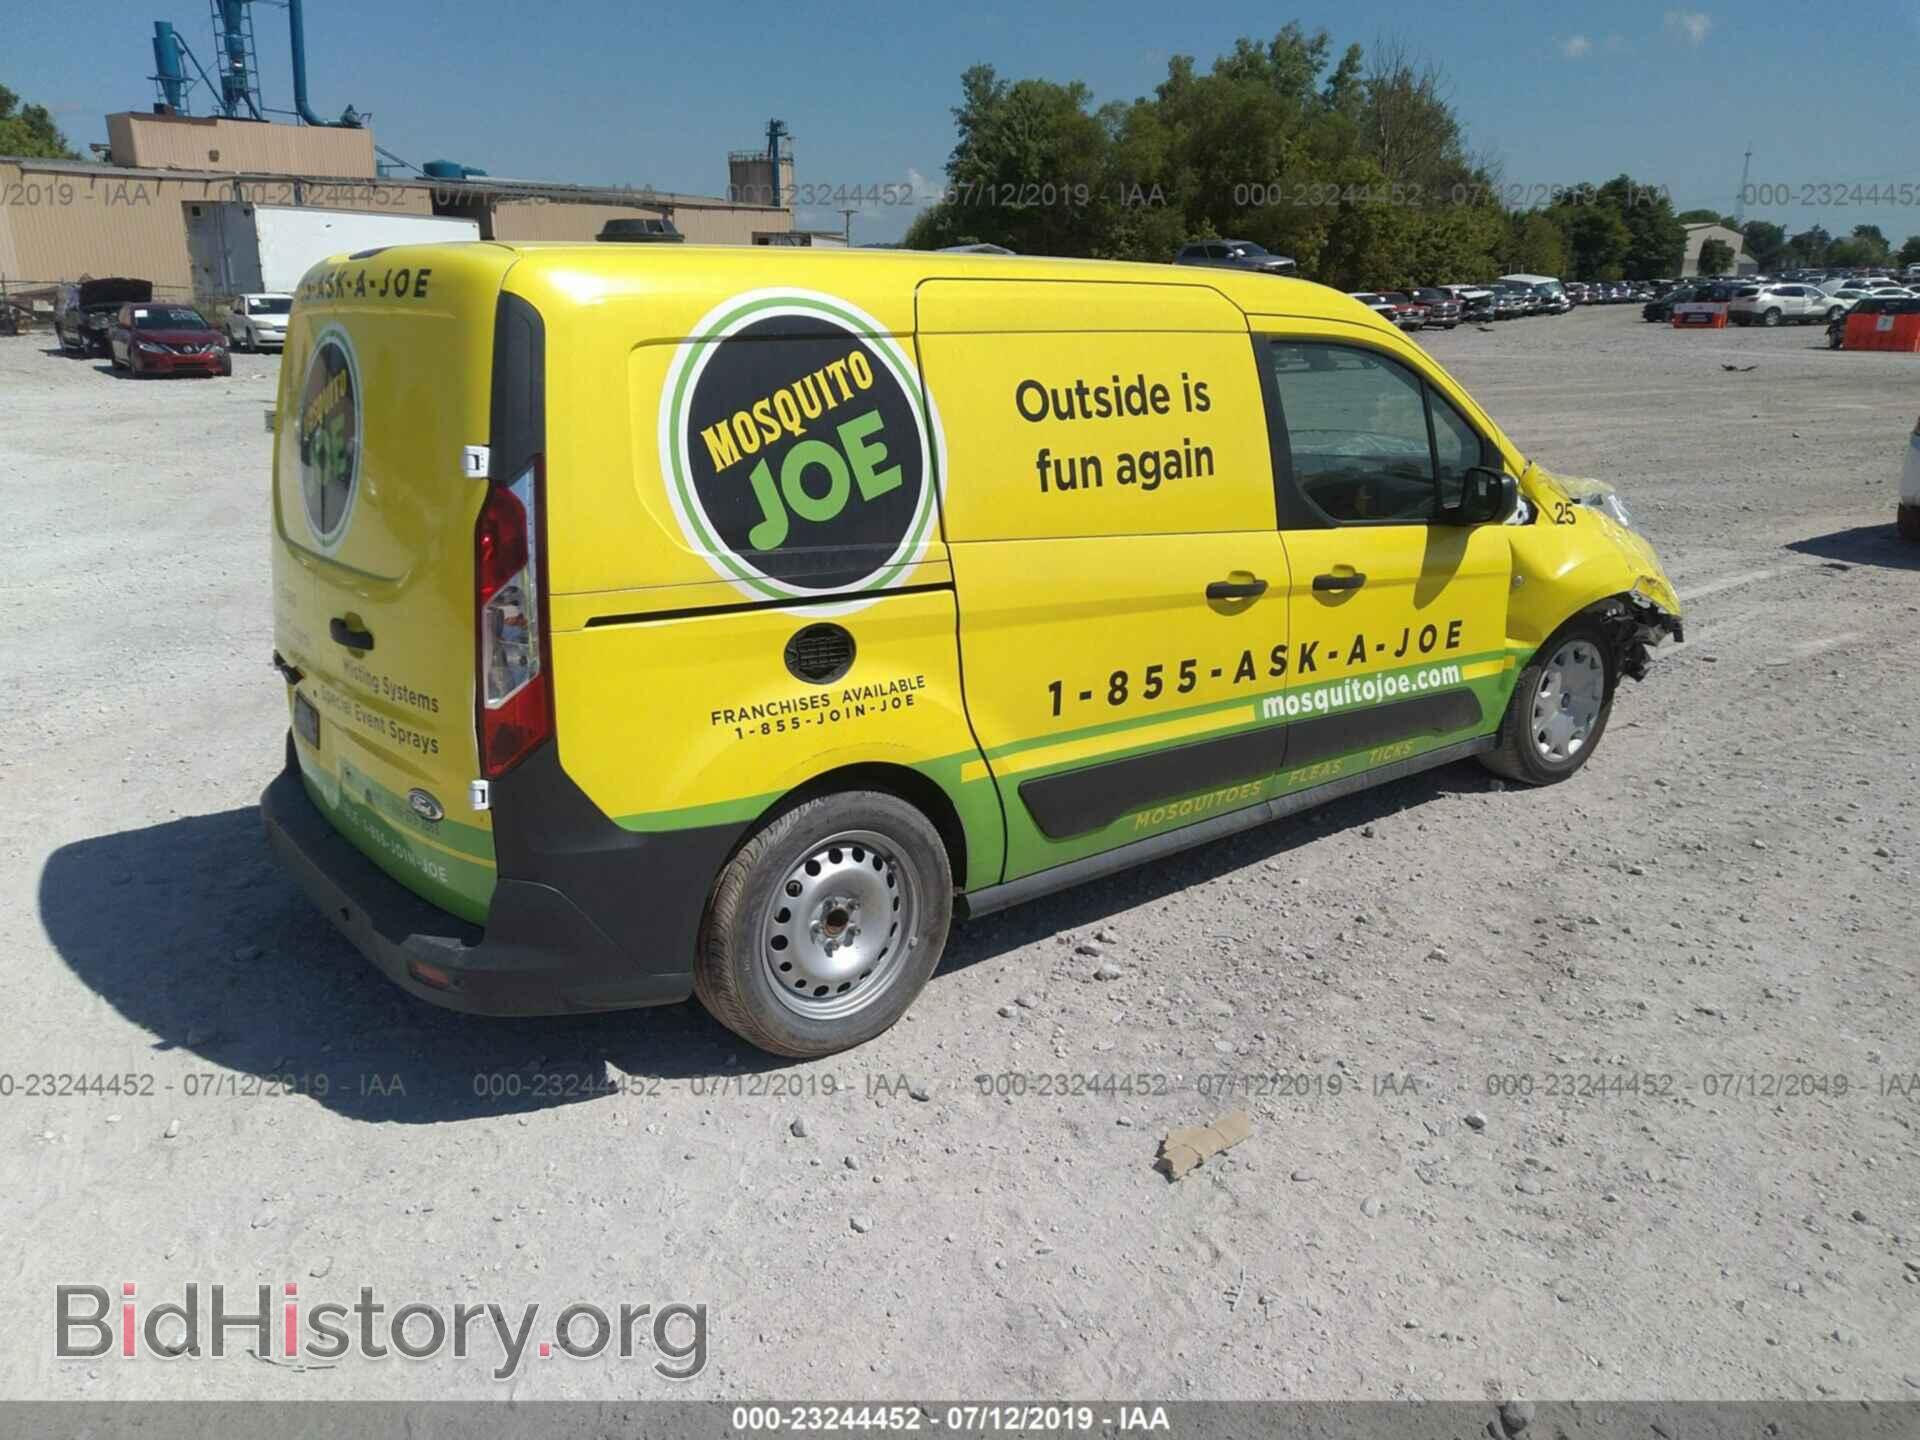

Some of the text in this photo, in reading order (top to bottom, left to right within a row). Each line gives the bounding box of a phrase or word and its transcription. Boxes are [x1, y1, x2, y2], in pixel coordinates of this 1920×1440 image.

[701, 350, 874, 473] MOSQUITO
[1015, 371, 1211, 422] Outside is
[748, 408, 903, 551] JOE
[1036, 437, 1214, 492] fun again
[1554, 501, 1577, 525] 25
[382, 676, 440, 713] Systems
[1047, 620, 1463, 717] 1-855-ASK-A-JOE
[1262, 663, 1461, 720] mosquitojoe.com
[710, 674, 926, 726] FRANCHISES AVAILABLE
[734, 693, 915, 740] 1-855-JOIN-JOE
[354, 702, 387, 735] Event
[388, 720, 440, 755] Sprays
[1134, 740, 1416, 830] MOSQUITOES FLEAS TICKS
